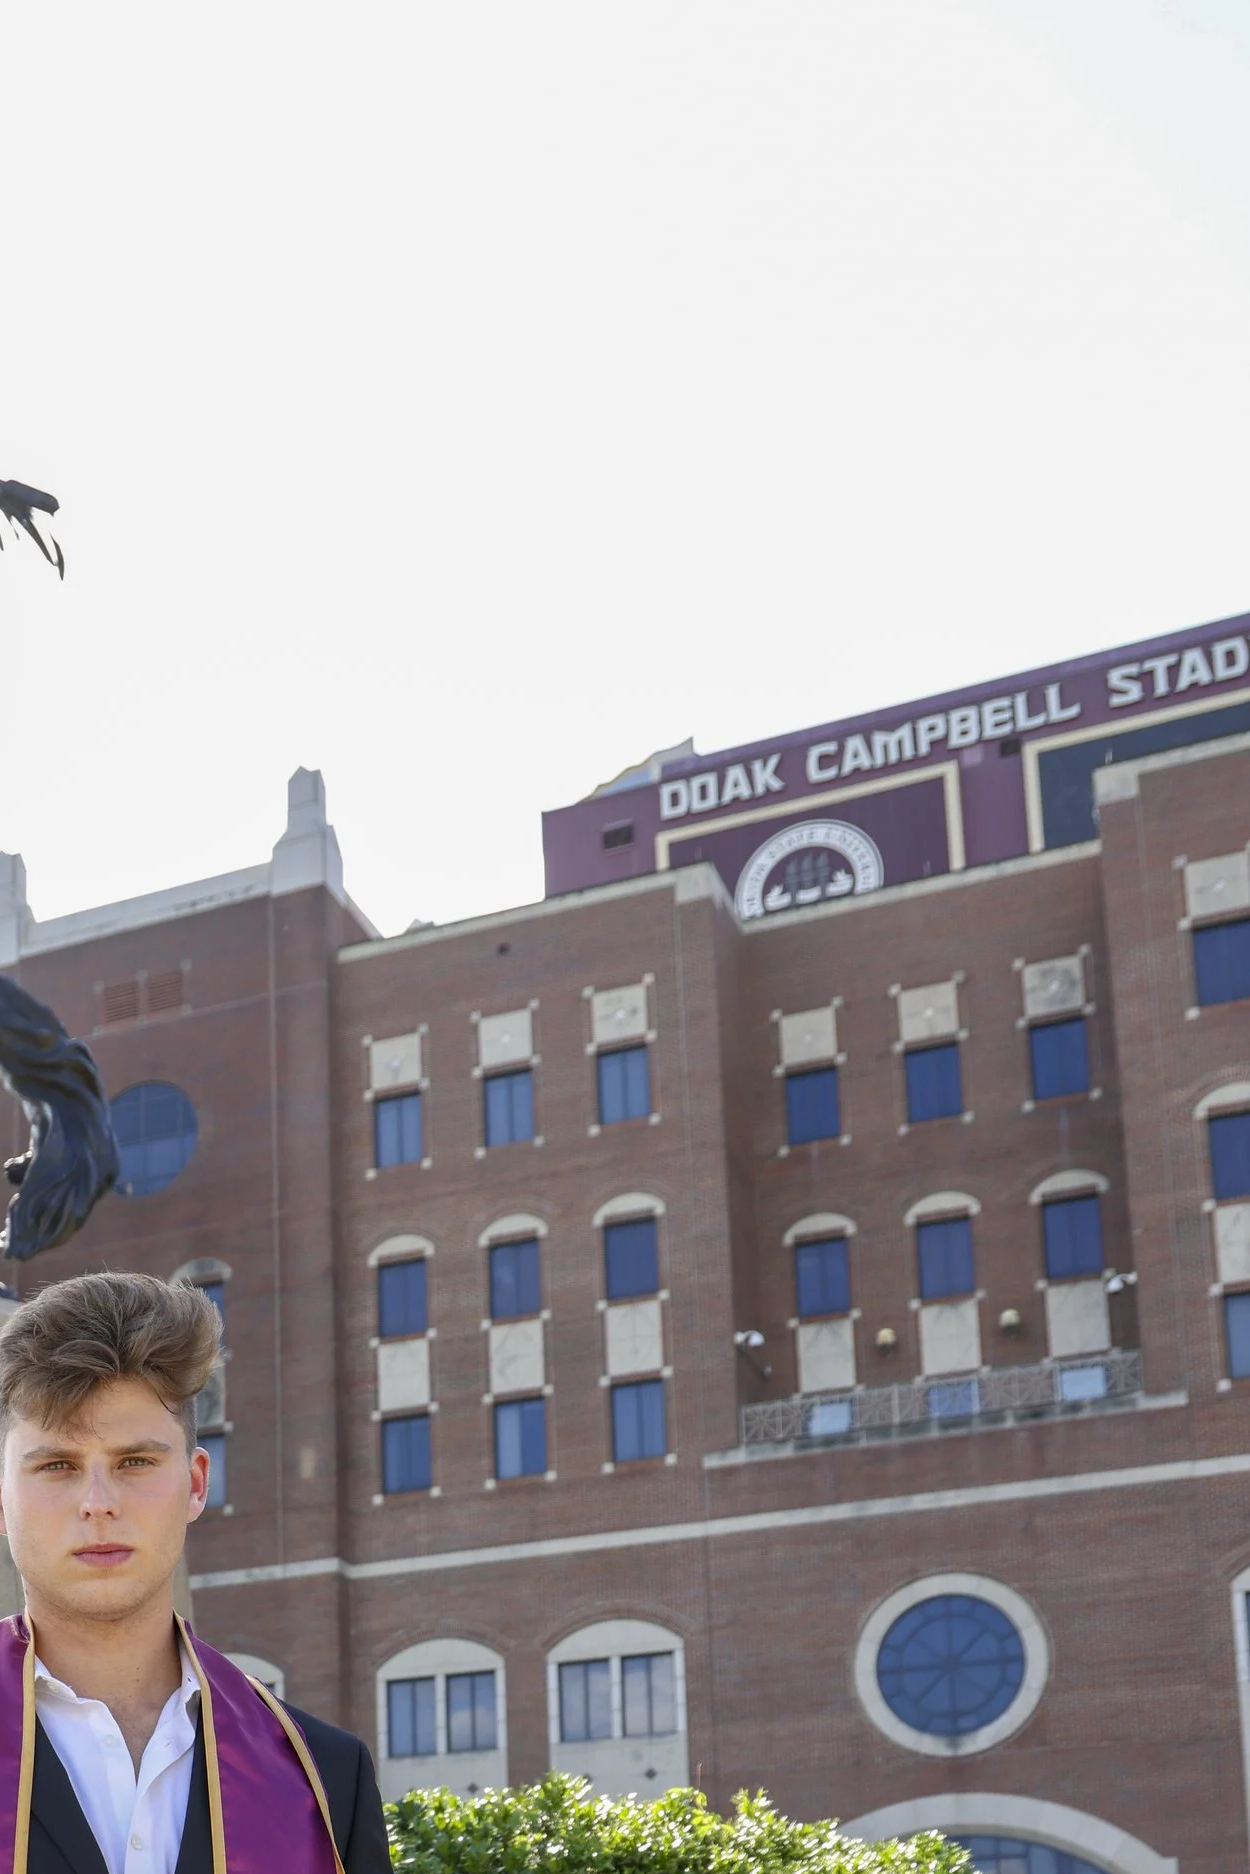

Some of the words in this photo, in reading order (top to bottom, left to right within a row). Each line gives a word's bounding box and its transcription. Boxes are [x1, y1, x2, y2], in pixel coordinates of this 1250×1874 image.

[659, 752, 785, 820] DOAK
[805, 682, 1081, 784] CAMPBELL
[1106, 635, 1250, 708] STAD
